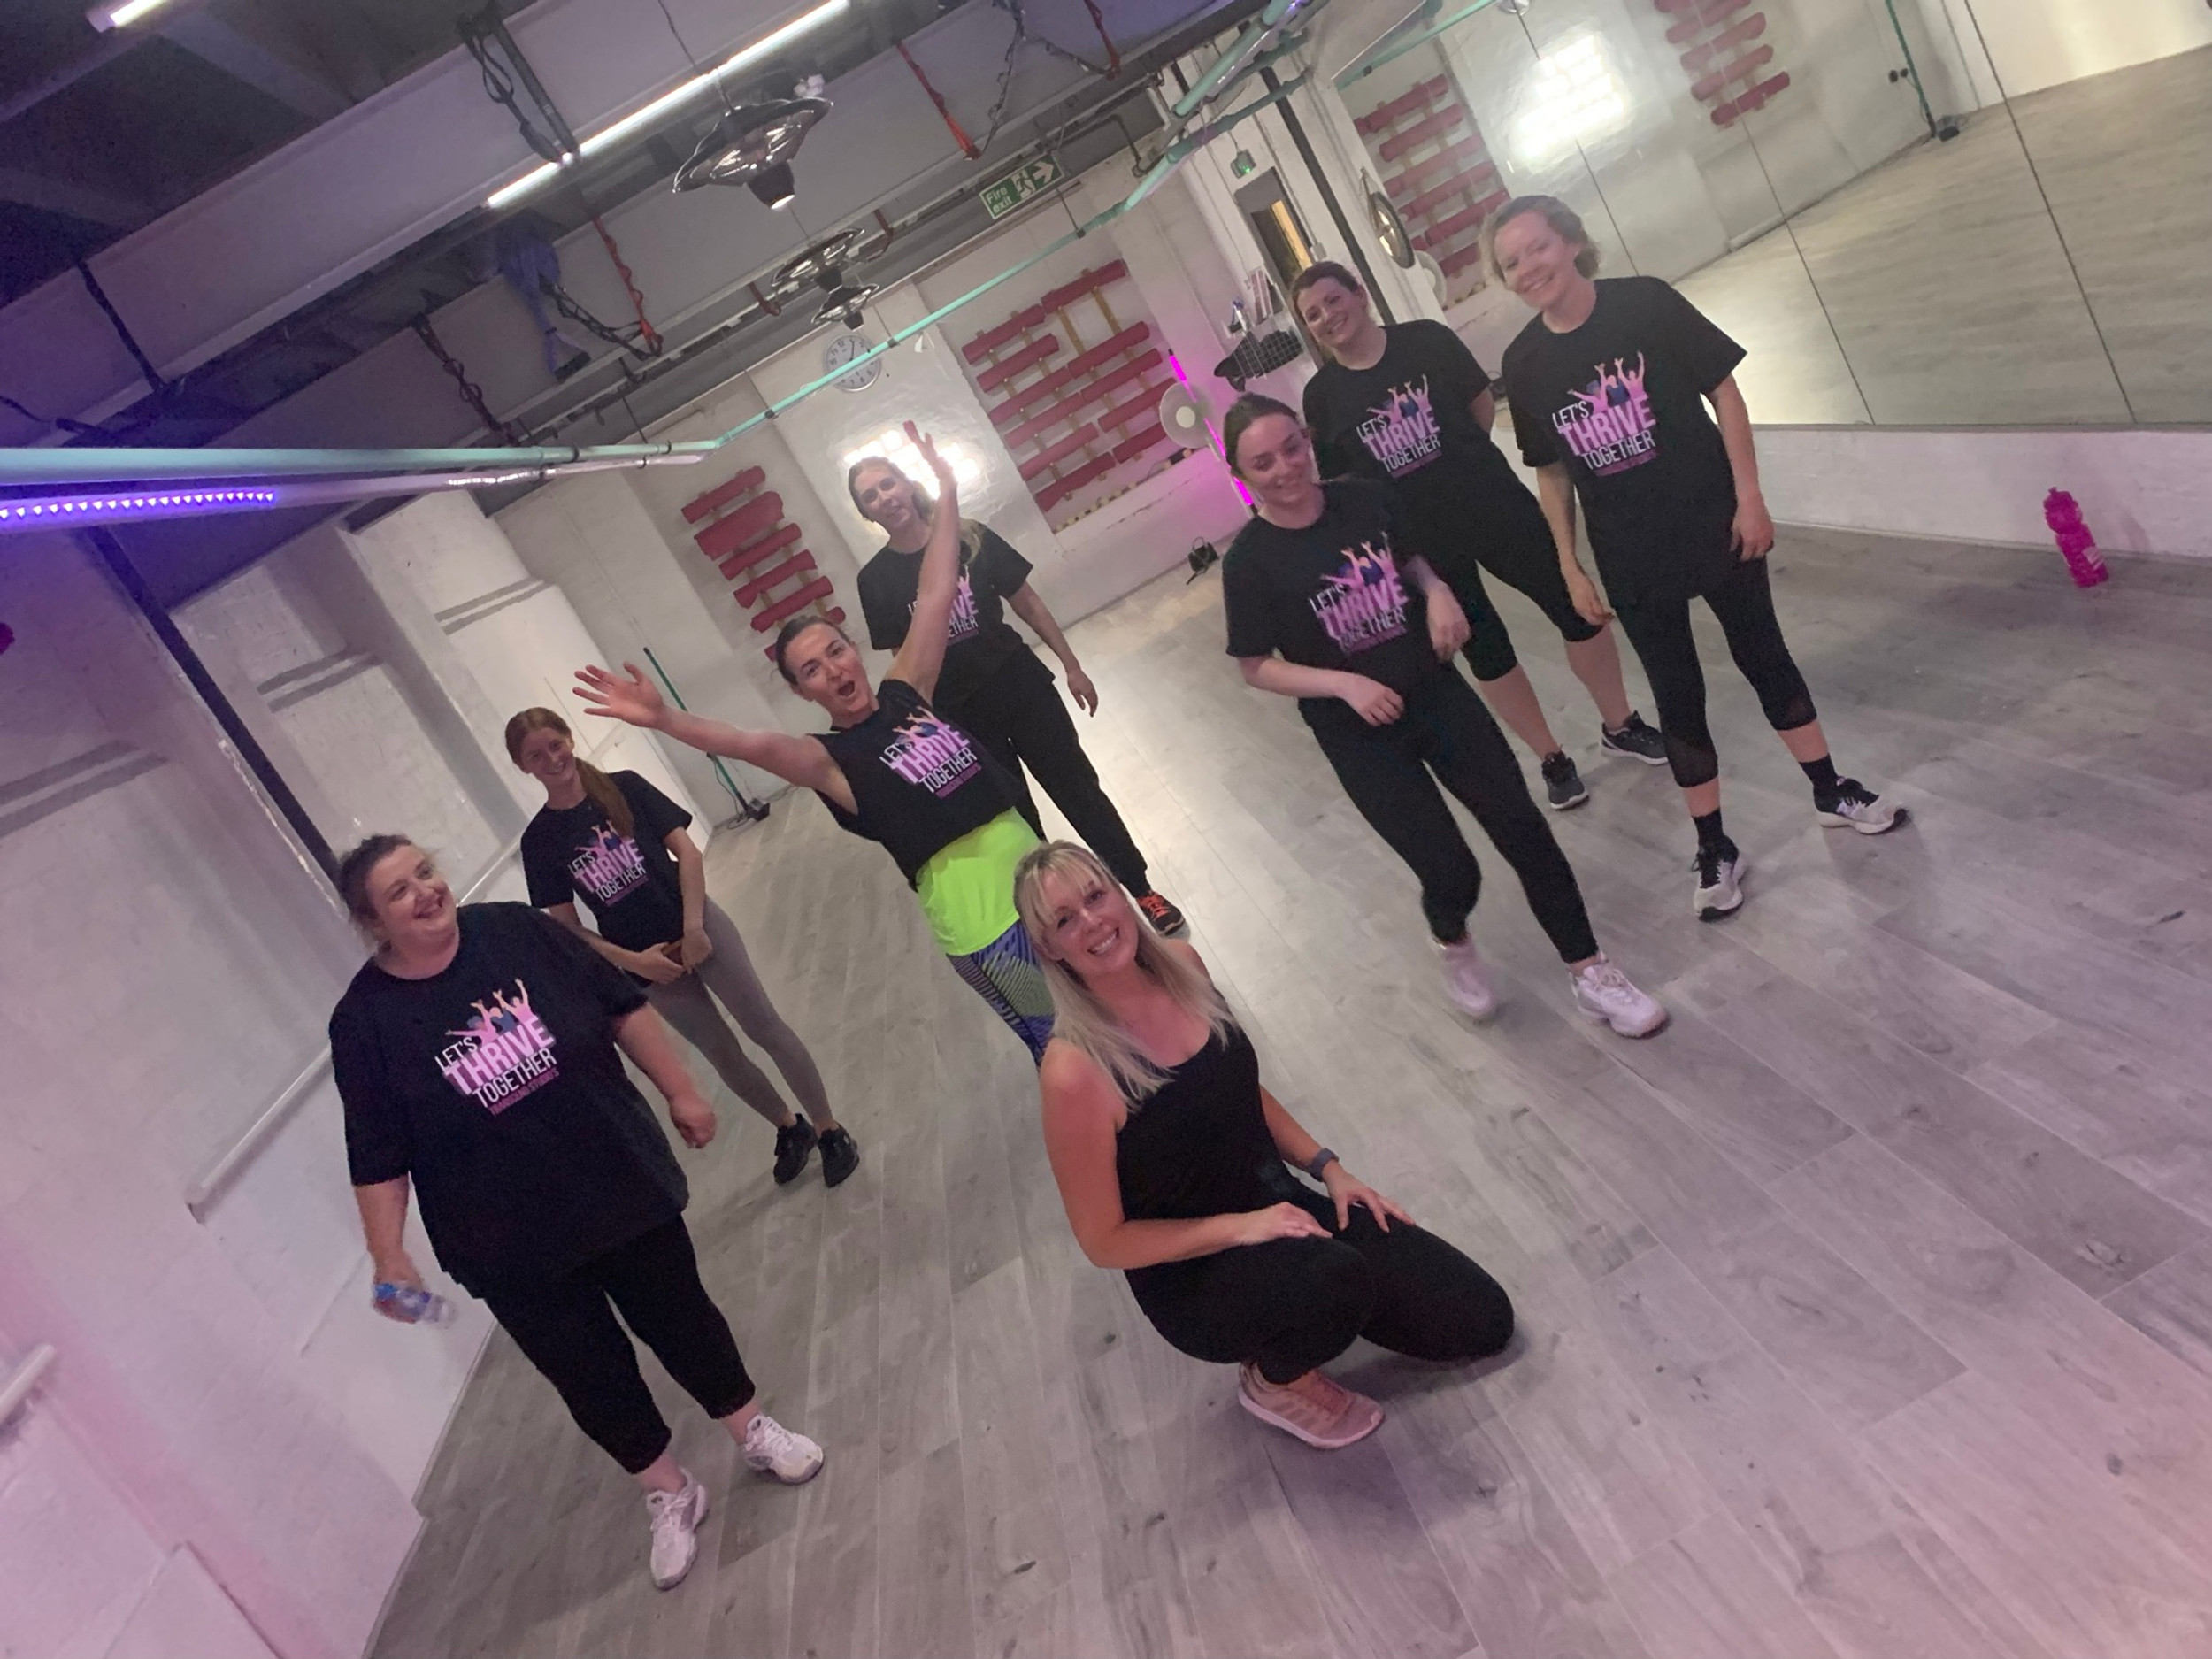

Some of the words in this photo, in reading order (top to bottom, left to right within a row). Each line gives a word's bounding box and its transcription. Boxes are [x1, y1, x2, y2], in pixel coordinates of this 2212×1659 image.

[986, 188, 1007, 204] Fire
[993, 196, 1012, 213] exit
[1356, 414, 1387, 440] LET'S
[1361, 406, 1440, 460] THRIVE
[1552, 401, 1589, 428] LET'S
[1557, 396, 1656, 456] THRIVE
[1380, 434, 1441, 472] TOGETHER
[1581, 429, 1655, 470] TOGETHER
[948, 615, 979, 638] ETHER
[890, 725, 970, 784] THRIVE
[918, 747, 978, 793] TOGETHER
[567, 850, 595, 874] LET'S
[573, 838, 645, 893] THRIVE
[594, 863, 646, 902] TOGETHER
[434, 1036, 478, 1071] LET'S
[443, 1017, 556, 1096] THRIVE
[472, 1048, 557, 1108] TOGETHER
